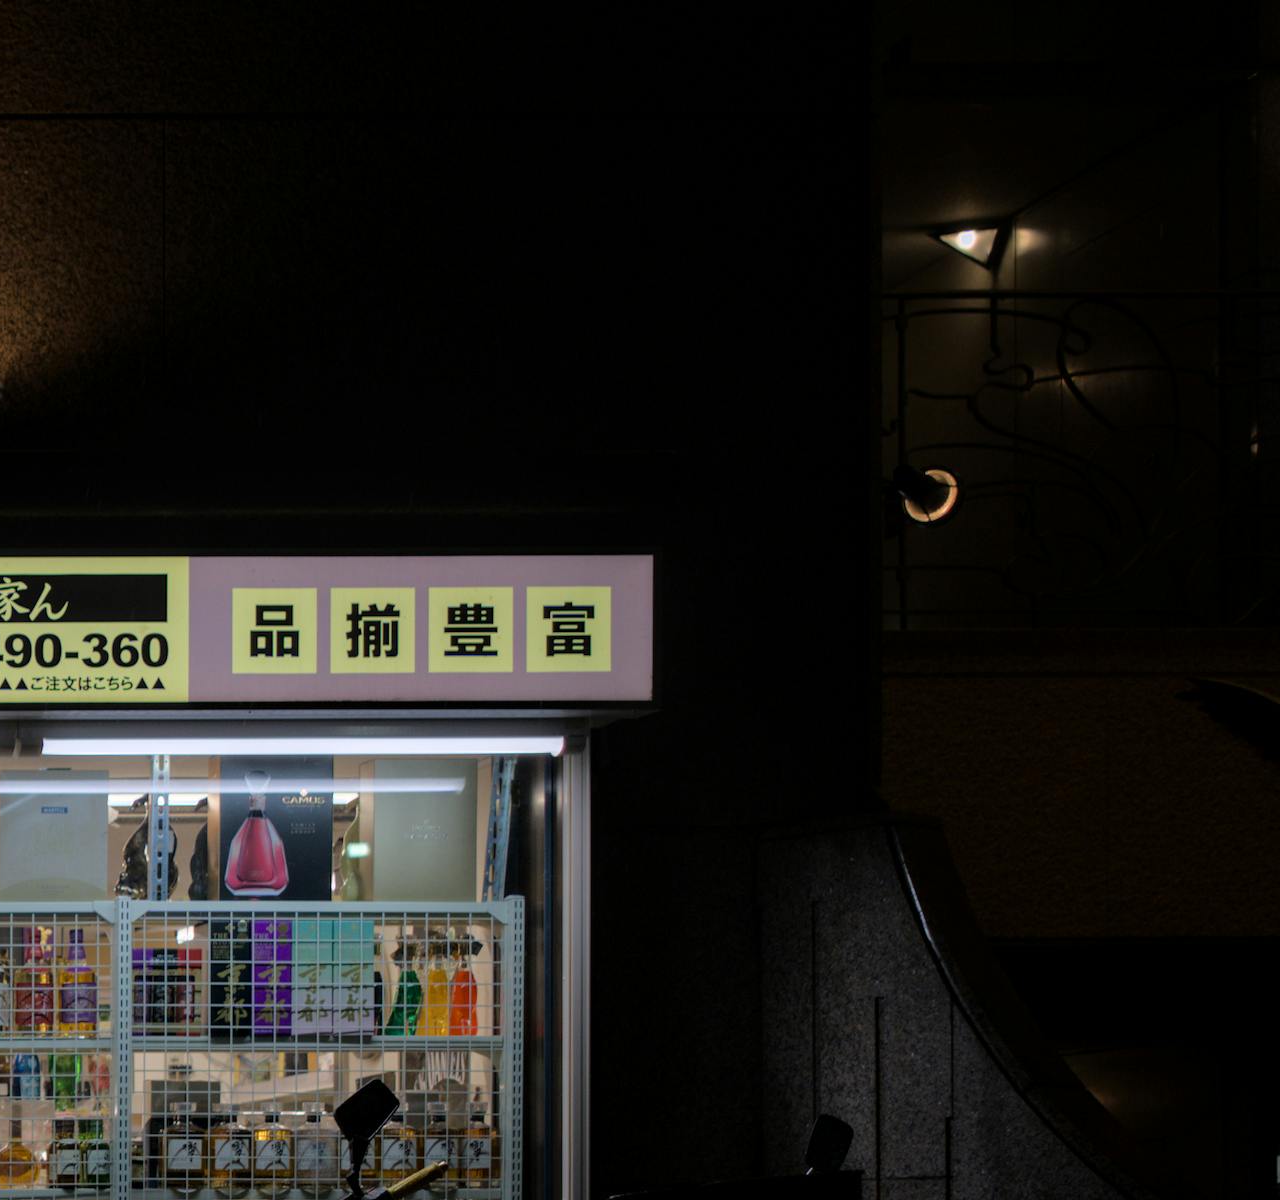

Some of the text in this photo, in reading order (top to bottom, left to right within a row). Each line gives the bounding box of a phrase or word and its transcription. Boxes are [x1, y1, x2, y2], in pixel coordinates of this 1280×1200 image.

[249, 602, 596, 658] 品揃豊富
[30, 676, 134, 692] ご注文はこちら
[282, 796, 325, 804] CAMUS
